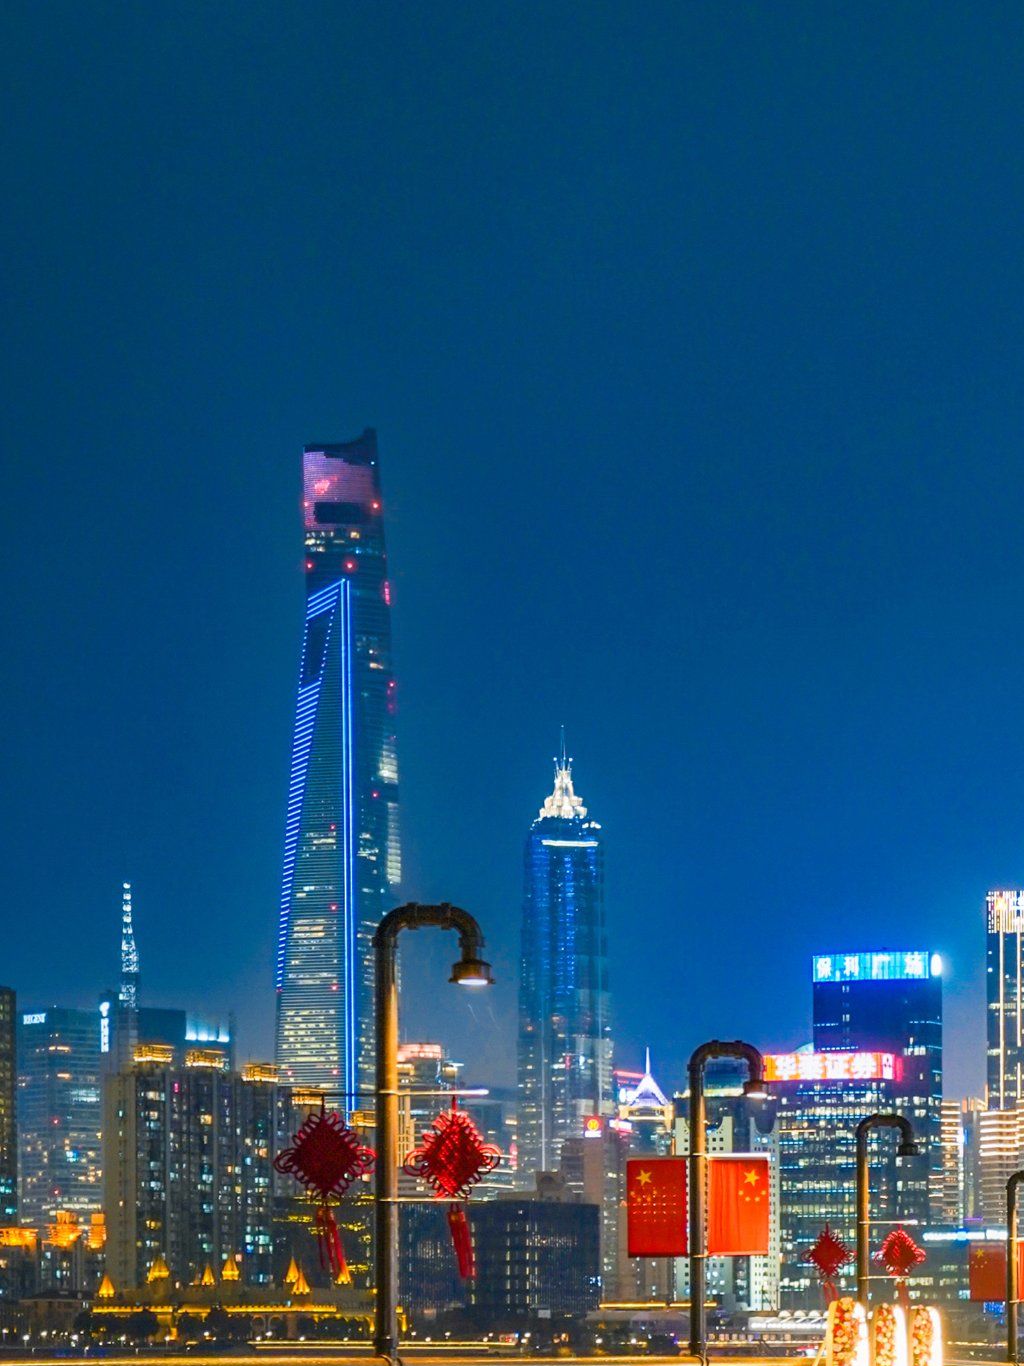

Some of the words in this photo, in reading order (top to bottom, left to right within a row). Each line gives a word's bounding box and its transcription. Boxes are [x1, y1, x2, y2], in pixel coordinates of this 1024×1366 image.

[816, 953, 925, 979] 保利广场
[774, 1053, 878, 1080] 华泰证券
